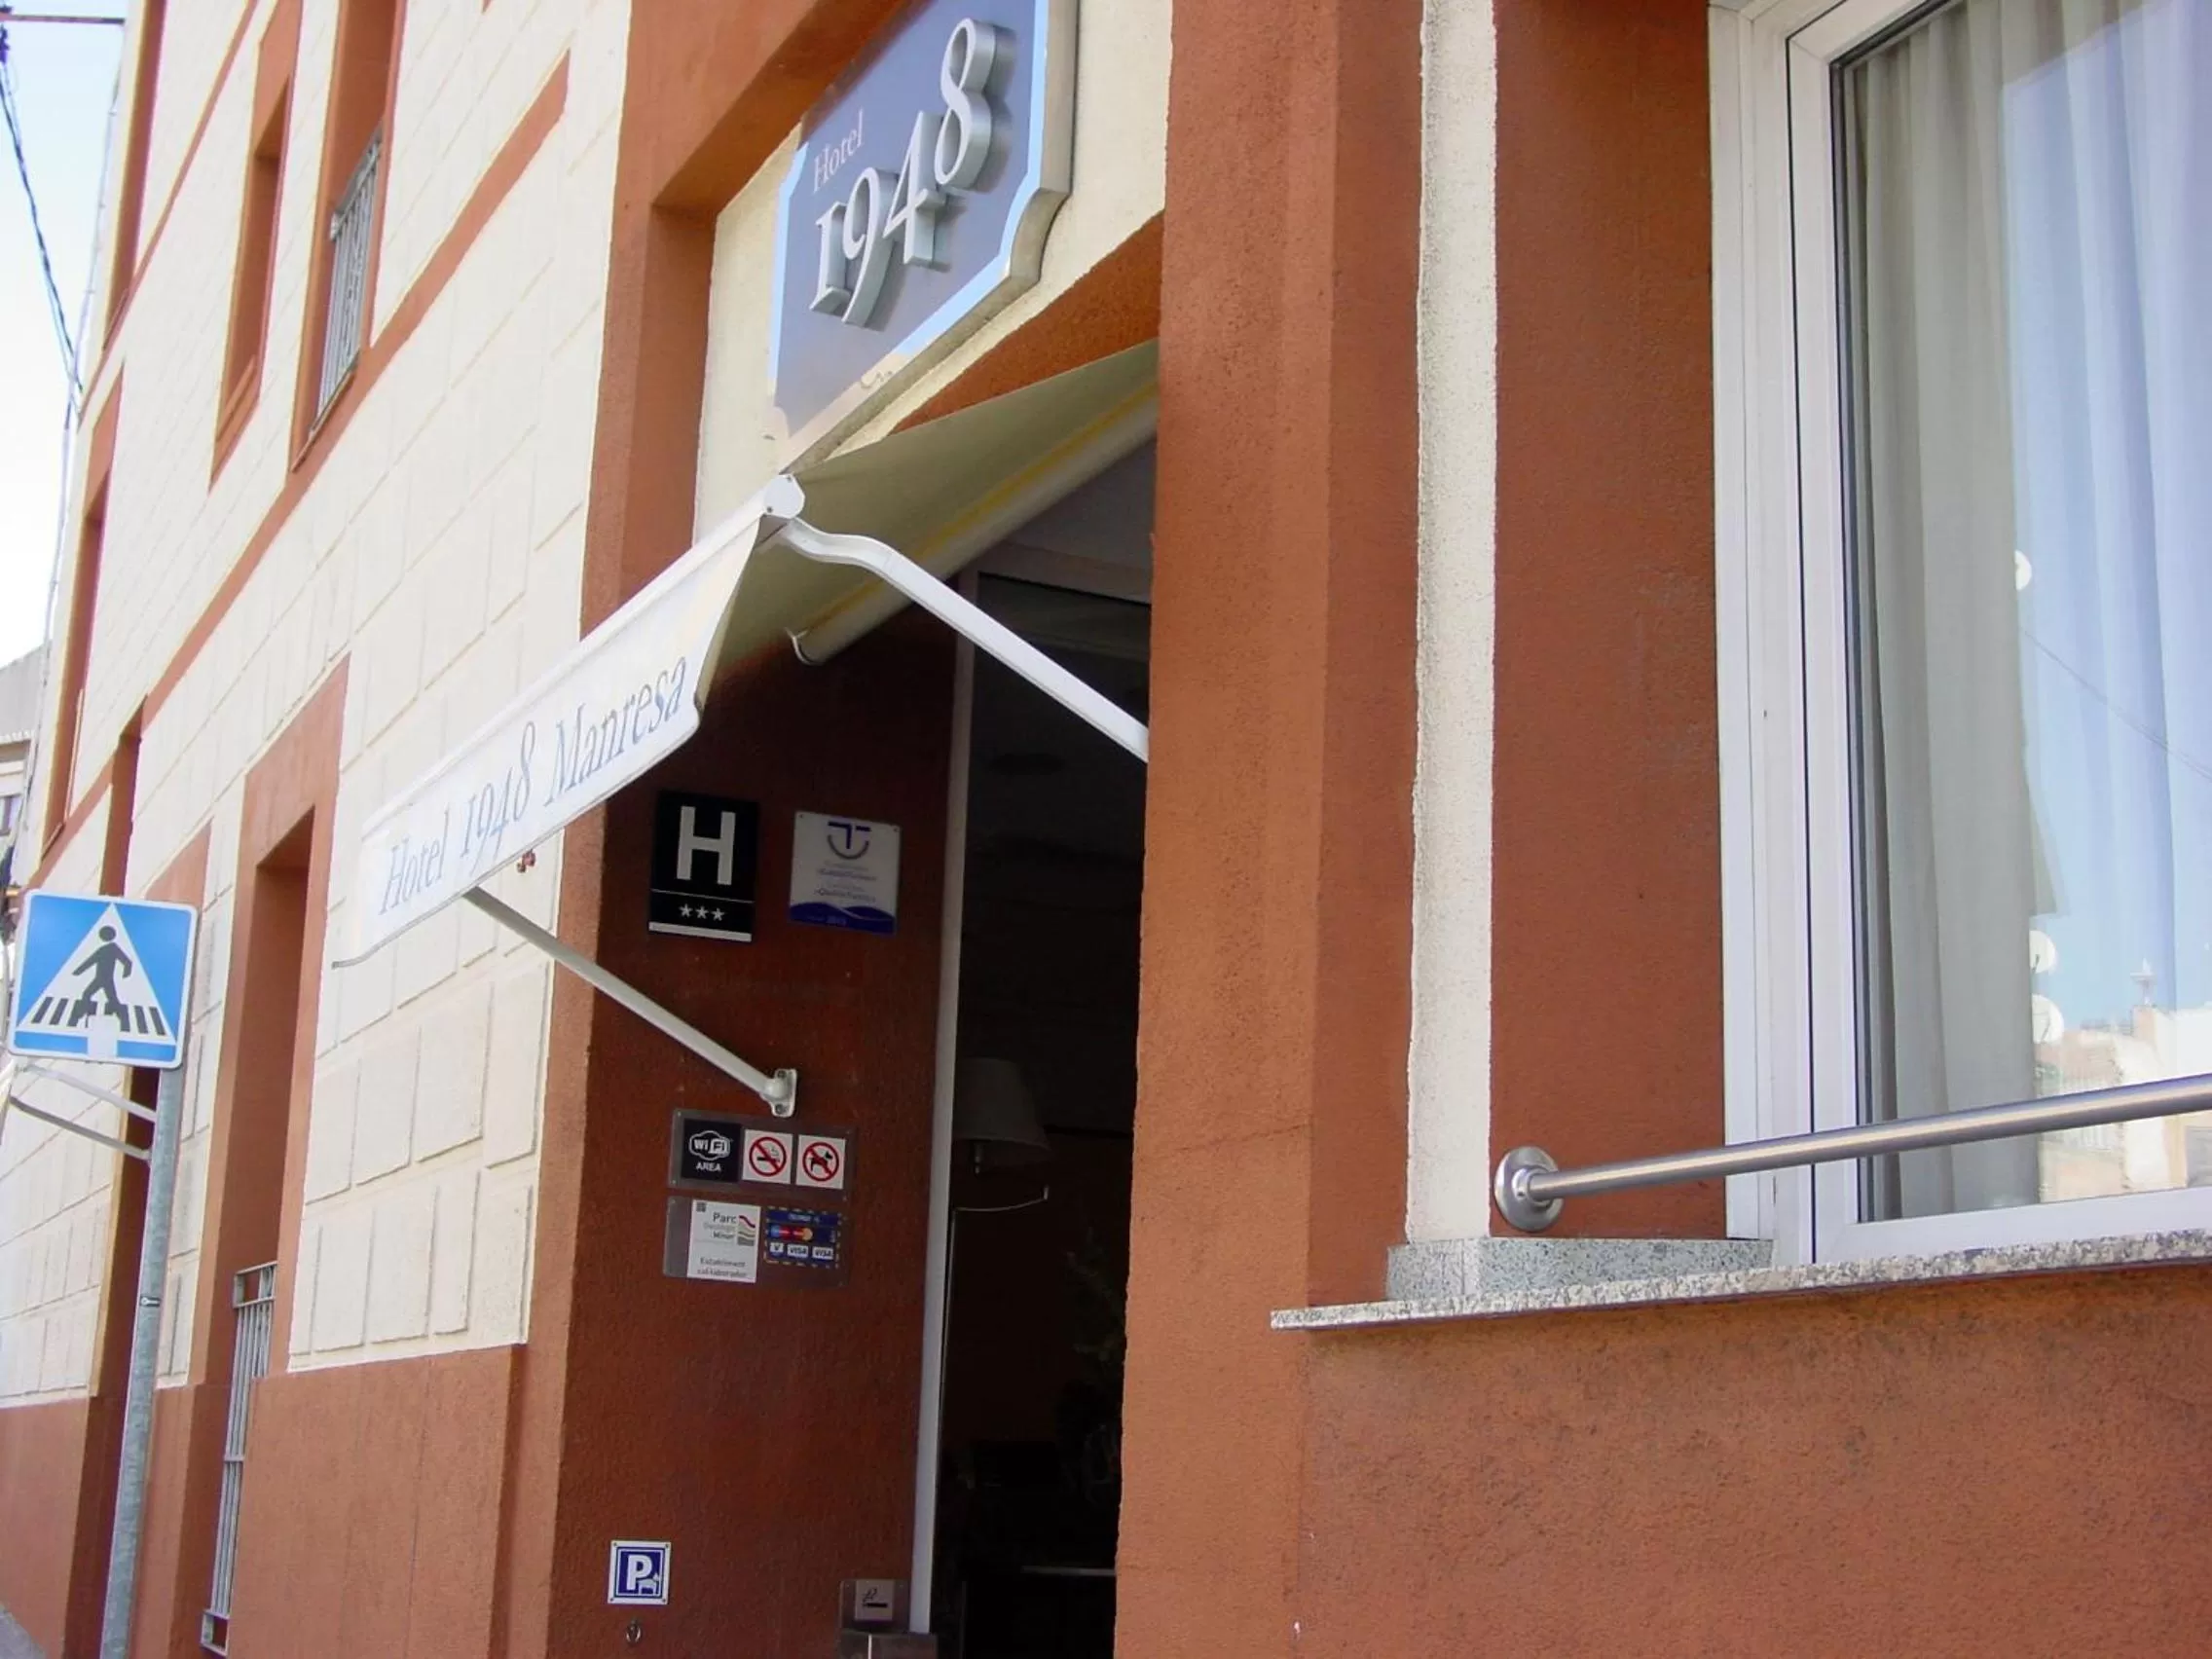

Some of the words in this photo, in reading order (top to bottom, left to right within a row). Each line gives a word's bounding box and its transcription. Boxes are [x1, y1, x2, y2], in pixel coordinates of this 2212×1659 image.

[809, 18, 994, 326] 1948
[813, 109, 864, 193] Hotel
[380, 807, 449, 915] Hotel
[460, 720, 535, 876] 1948
[543, 656, 686, 807] Manresa
[677, 805, 736, 886] H
[695, 1161, 721, 1172] AREA
[713, 1211, 737, 1223] Parc
[815, 1248, 831, 1257] VISA
[626, 1554, 652, 1590] P
